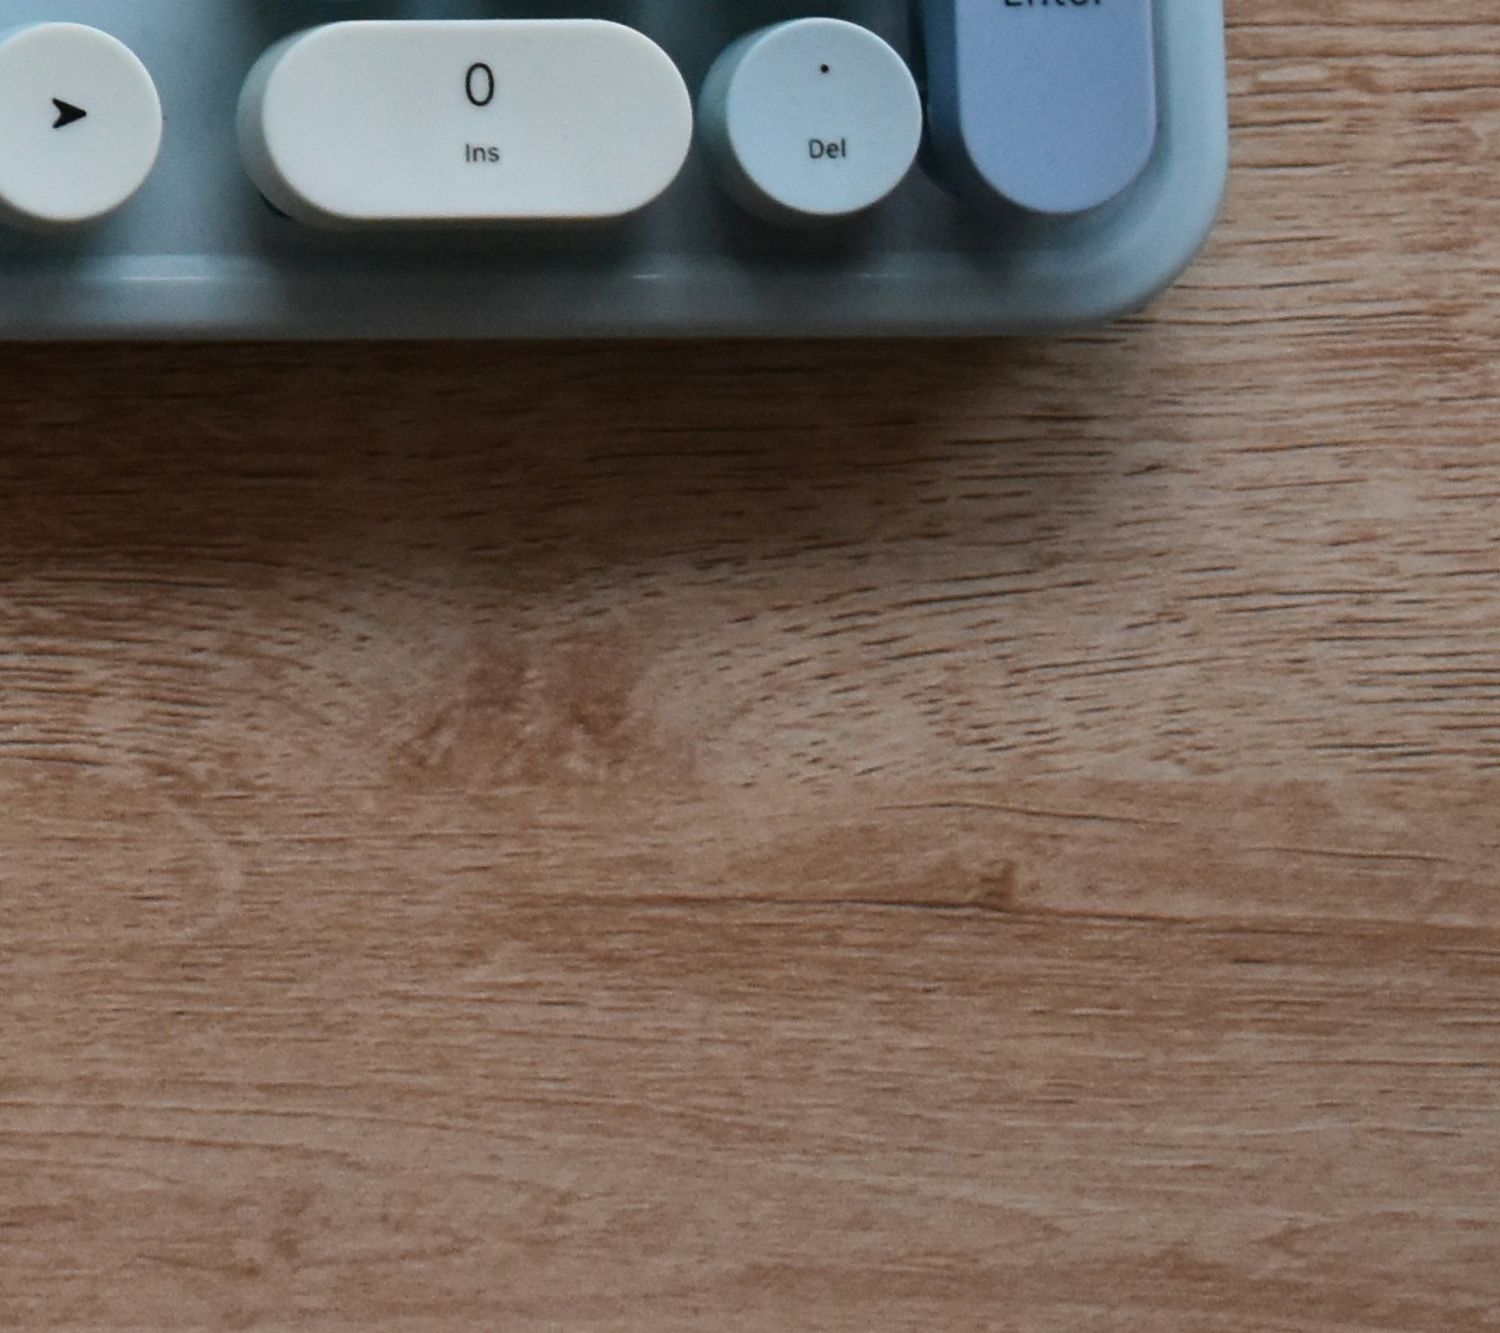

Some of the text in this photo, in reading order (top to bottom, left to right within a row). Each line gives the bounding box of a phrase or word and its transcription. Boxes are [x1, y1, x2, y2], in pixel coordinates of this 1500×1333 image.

[465, 62, 495, 107] 0
[466, 145, 499, 162] Ins
[809, 139, 846, 159] Del
